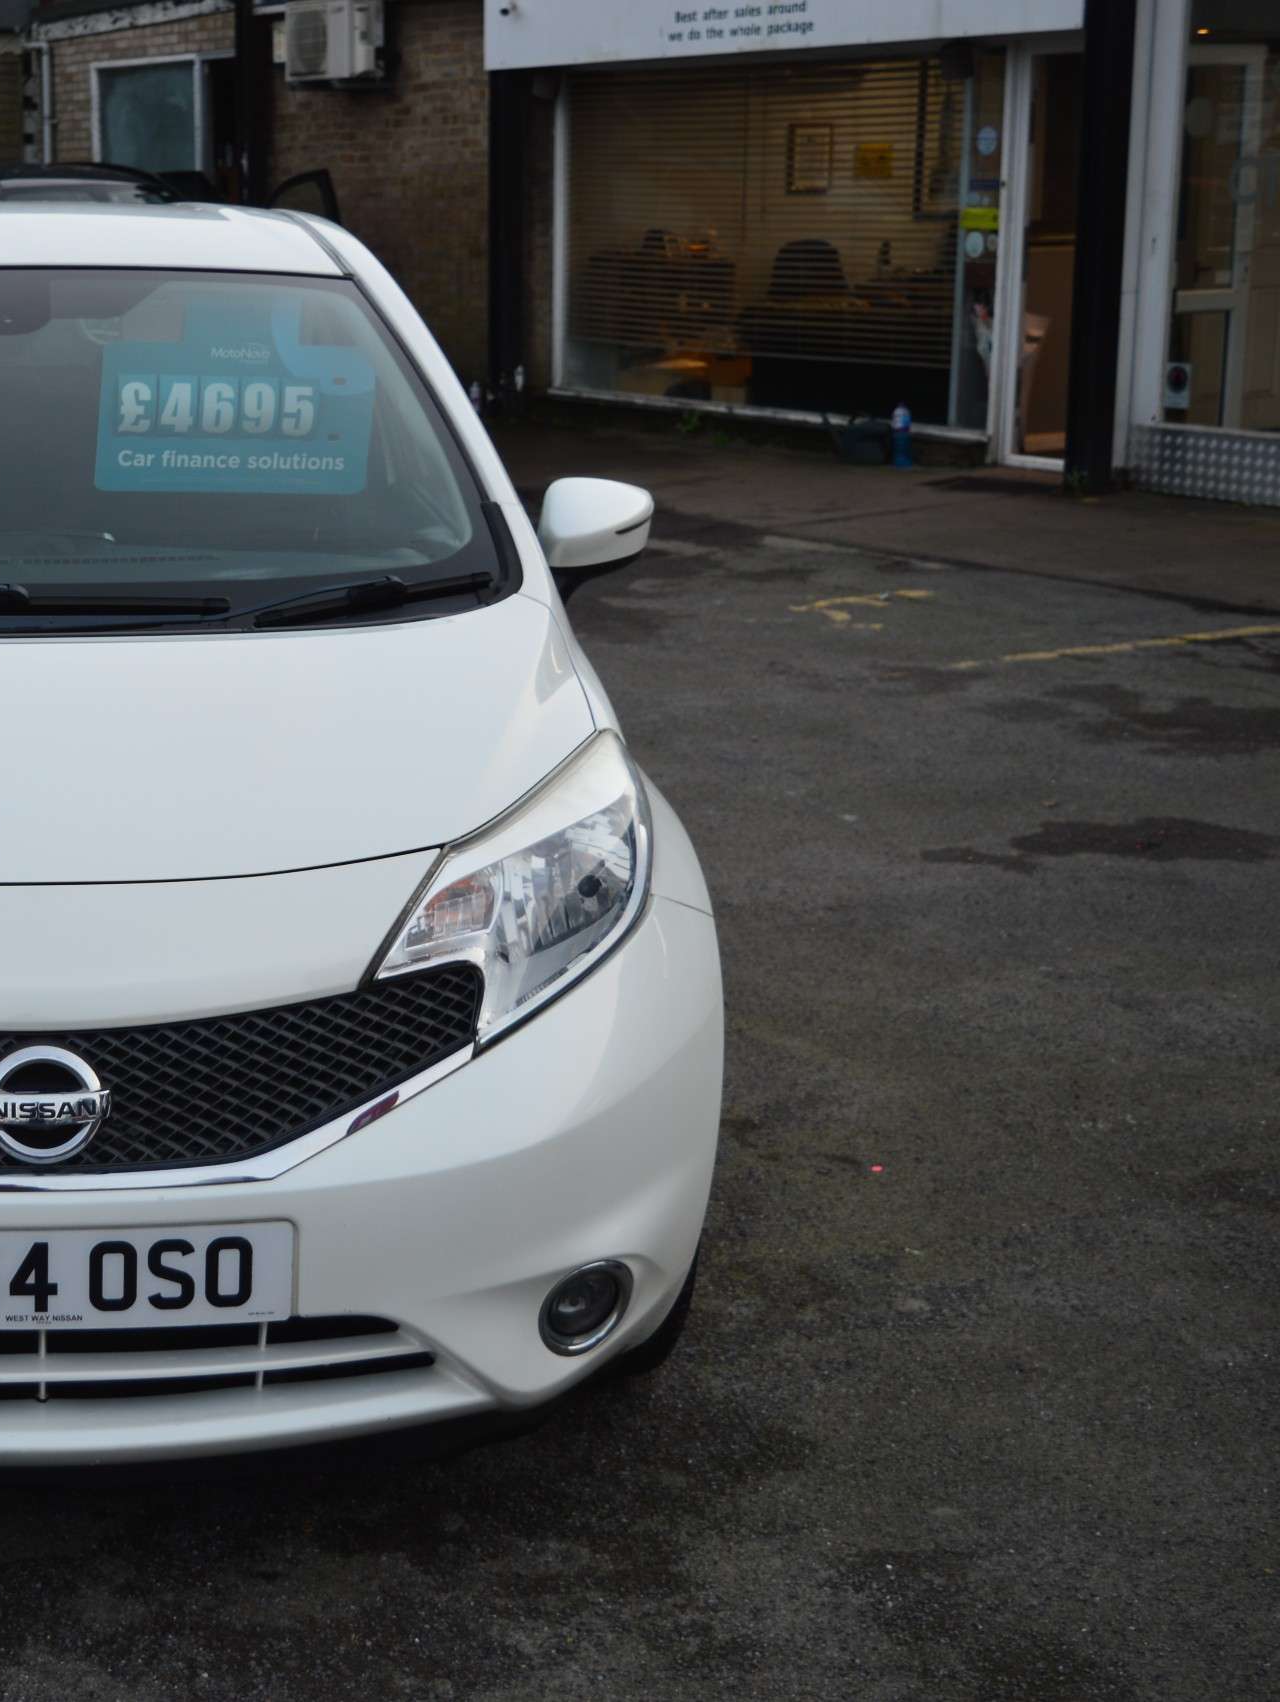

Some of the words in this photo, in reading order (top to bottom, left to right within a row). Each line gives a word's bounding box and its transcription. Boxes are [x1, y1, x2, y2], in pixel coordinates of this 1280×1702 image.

[675, 11, 697, 23] Best
[703, 8, 728, 20] after
[735, 5, 761, 17] sales
[768, 1, 806, 15] around
[688, 28, 700, 40] do
[706, 28, 723, 39] the
[730, 25, 760, 37] whole
[768, 21, 814, 36] package
[118, 382, 315, 437] £4695
[118, 450, 153, 467] Car
[161, 450, 240, 469] finance
[247, 452, 345, 471] solutions
[89, 1236, 254, 1312] OSO
